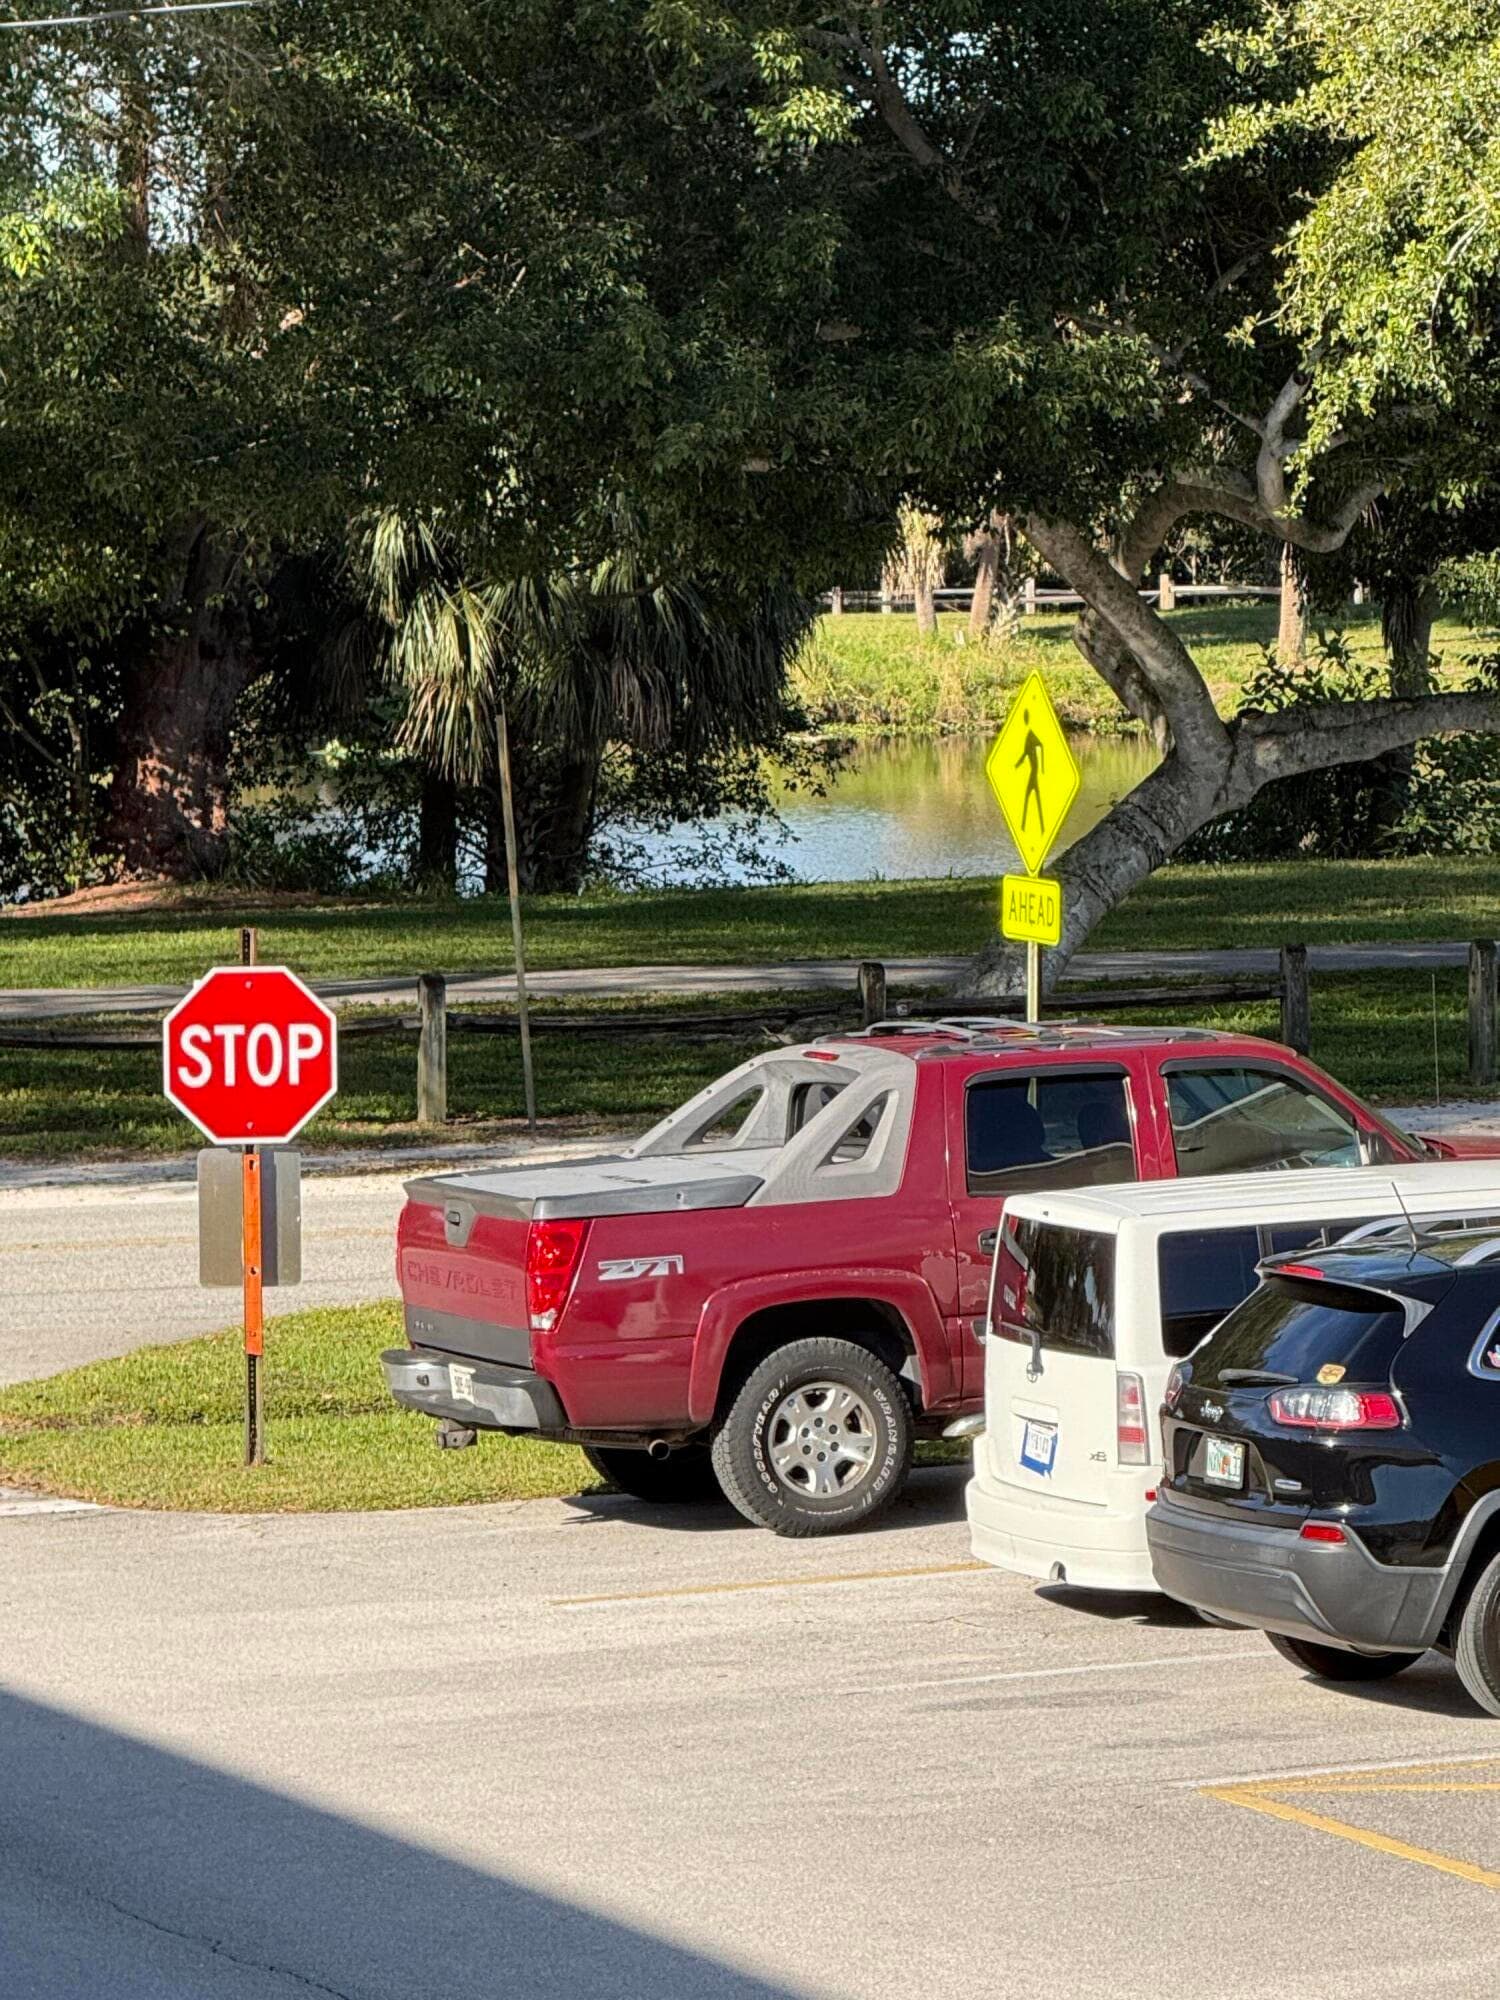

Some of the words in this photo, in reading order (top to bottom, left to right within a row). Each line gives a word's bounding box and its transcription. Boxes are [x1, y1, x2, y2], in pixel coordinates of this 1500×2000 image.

[1009, 890, 1055, 927] AHEAD
[177, 1023, 324, 1088] STOP
[598, 1255, 684, 1281] Z71
[1089, 1451, 1107, 1463] xB
